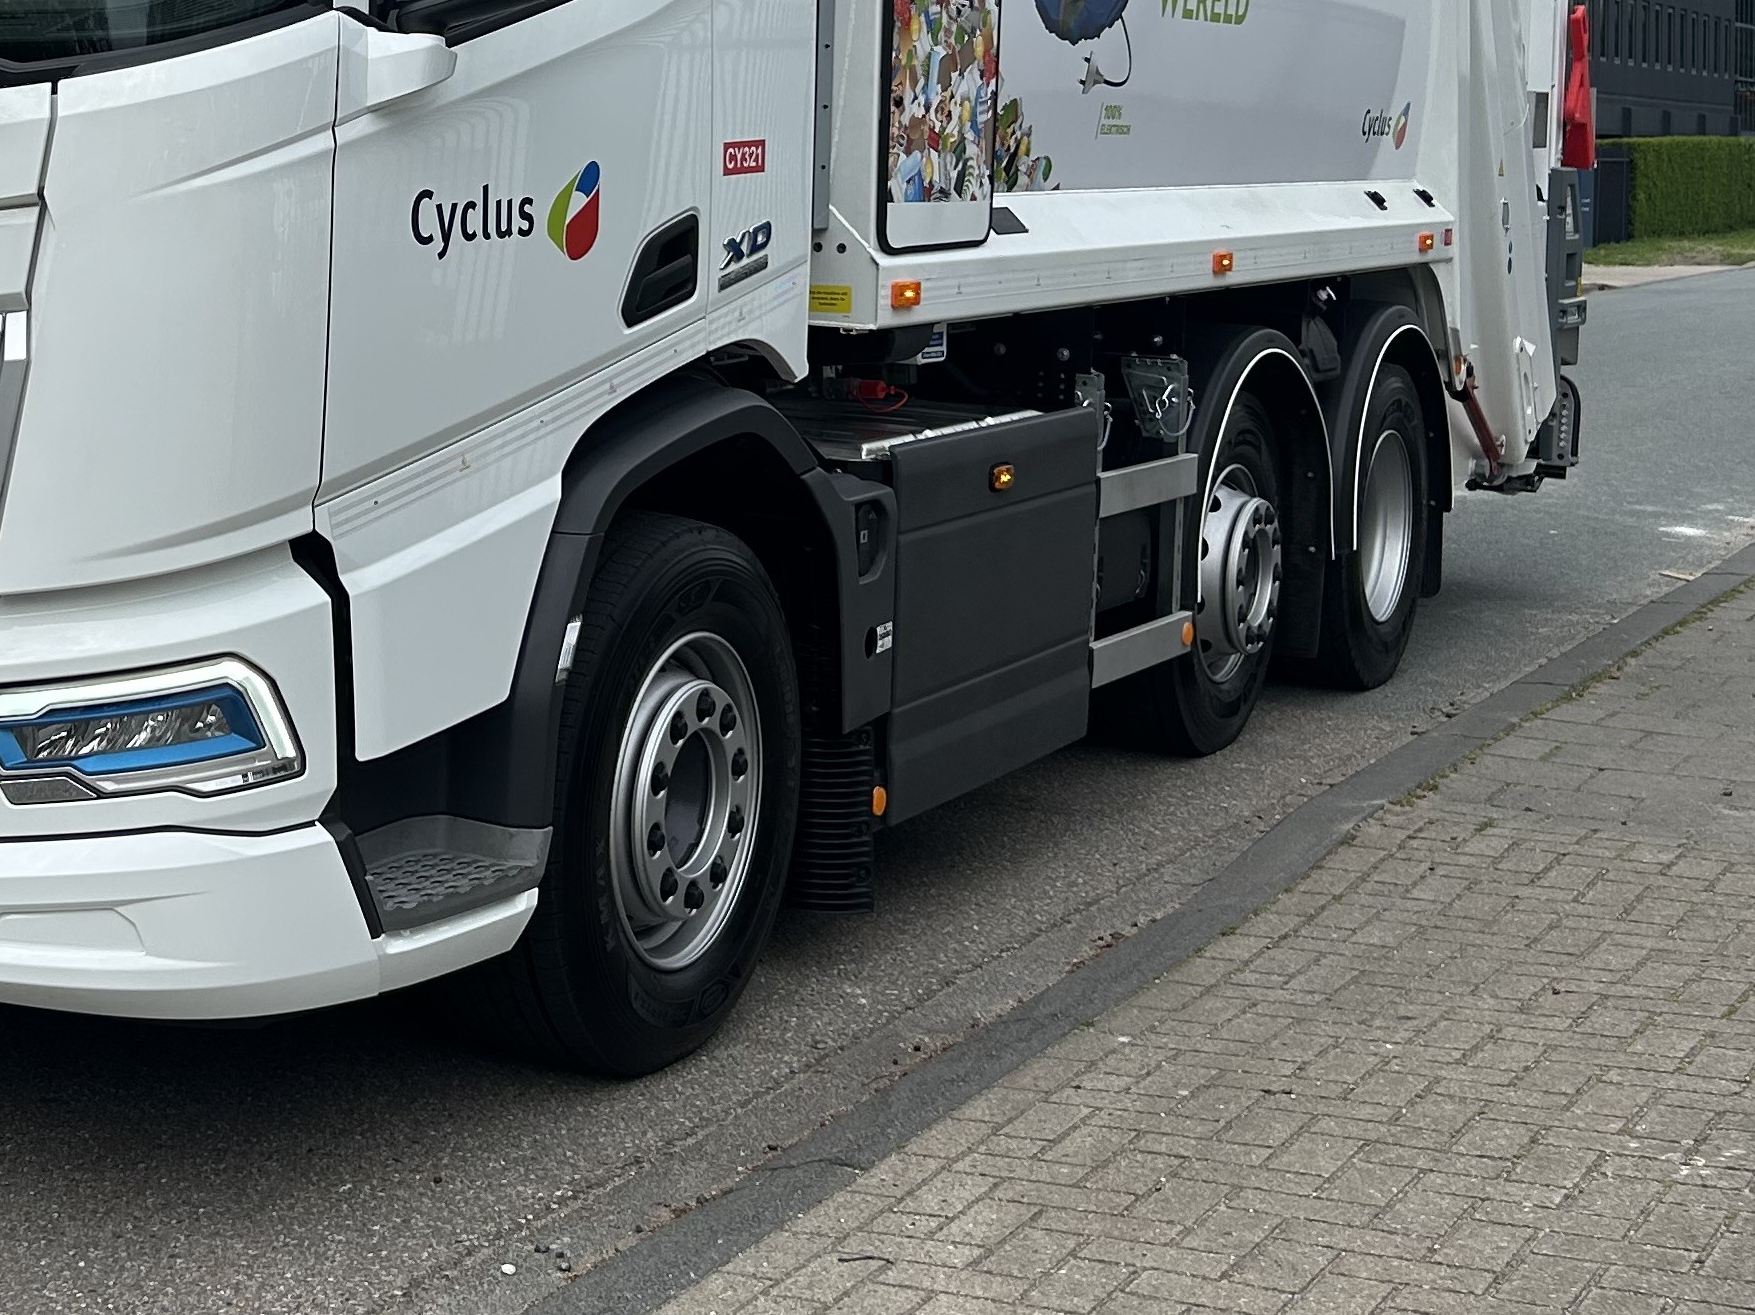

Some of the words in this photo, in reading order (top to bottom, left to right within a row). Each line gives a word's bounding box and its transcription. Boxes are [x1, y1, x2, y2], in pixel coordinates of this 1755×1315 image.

[1361, 108, 1393, 144] Cyclus
[725, 145, 763, 170] CY321
[411, 183, 535, 261] Cyclus
[719, 220, 773, 271] XD
